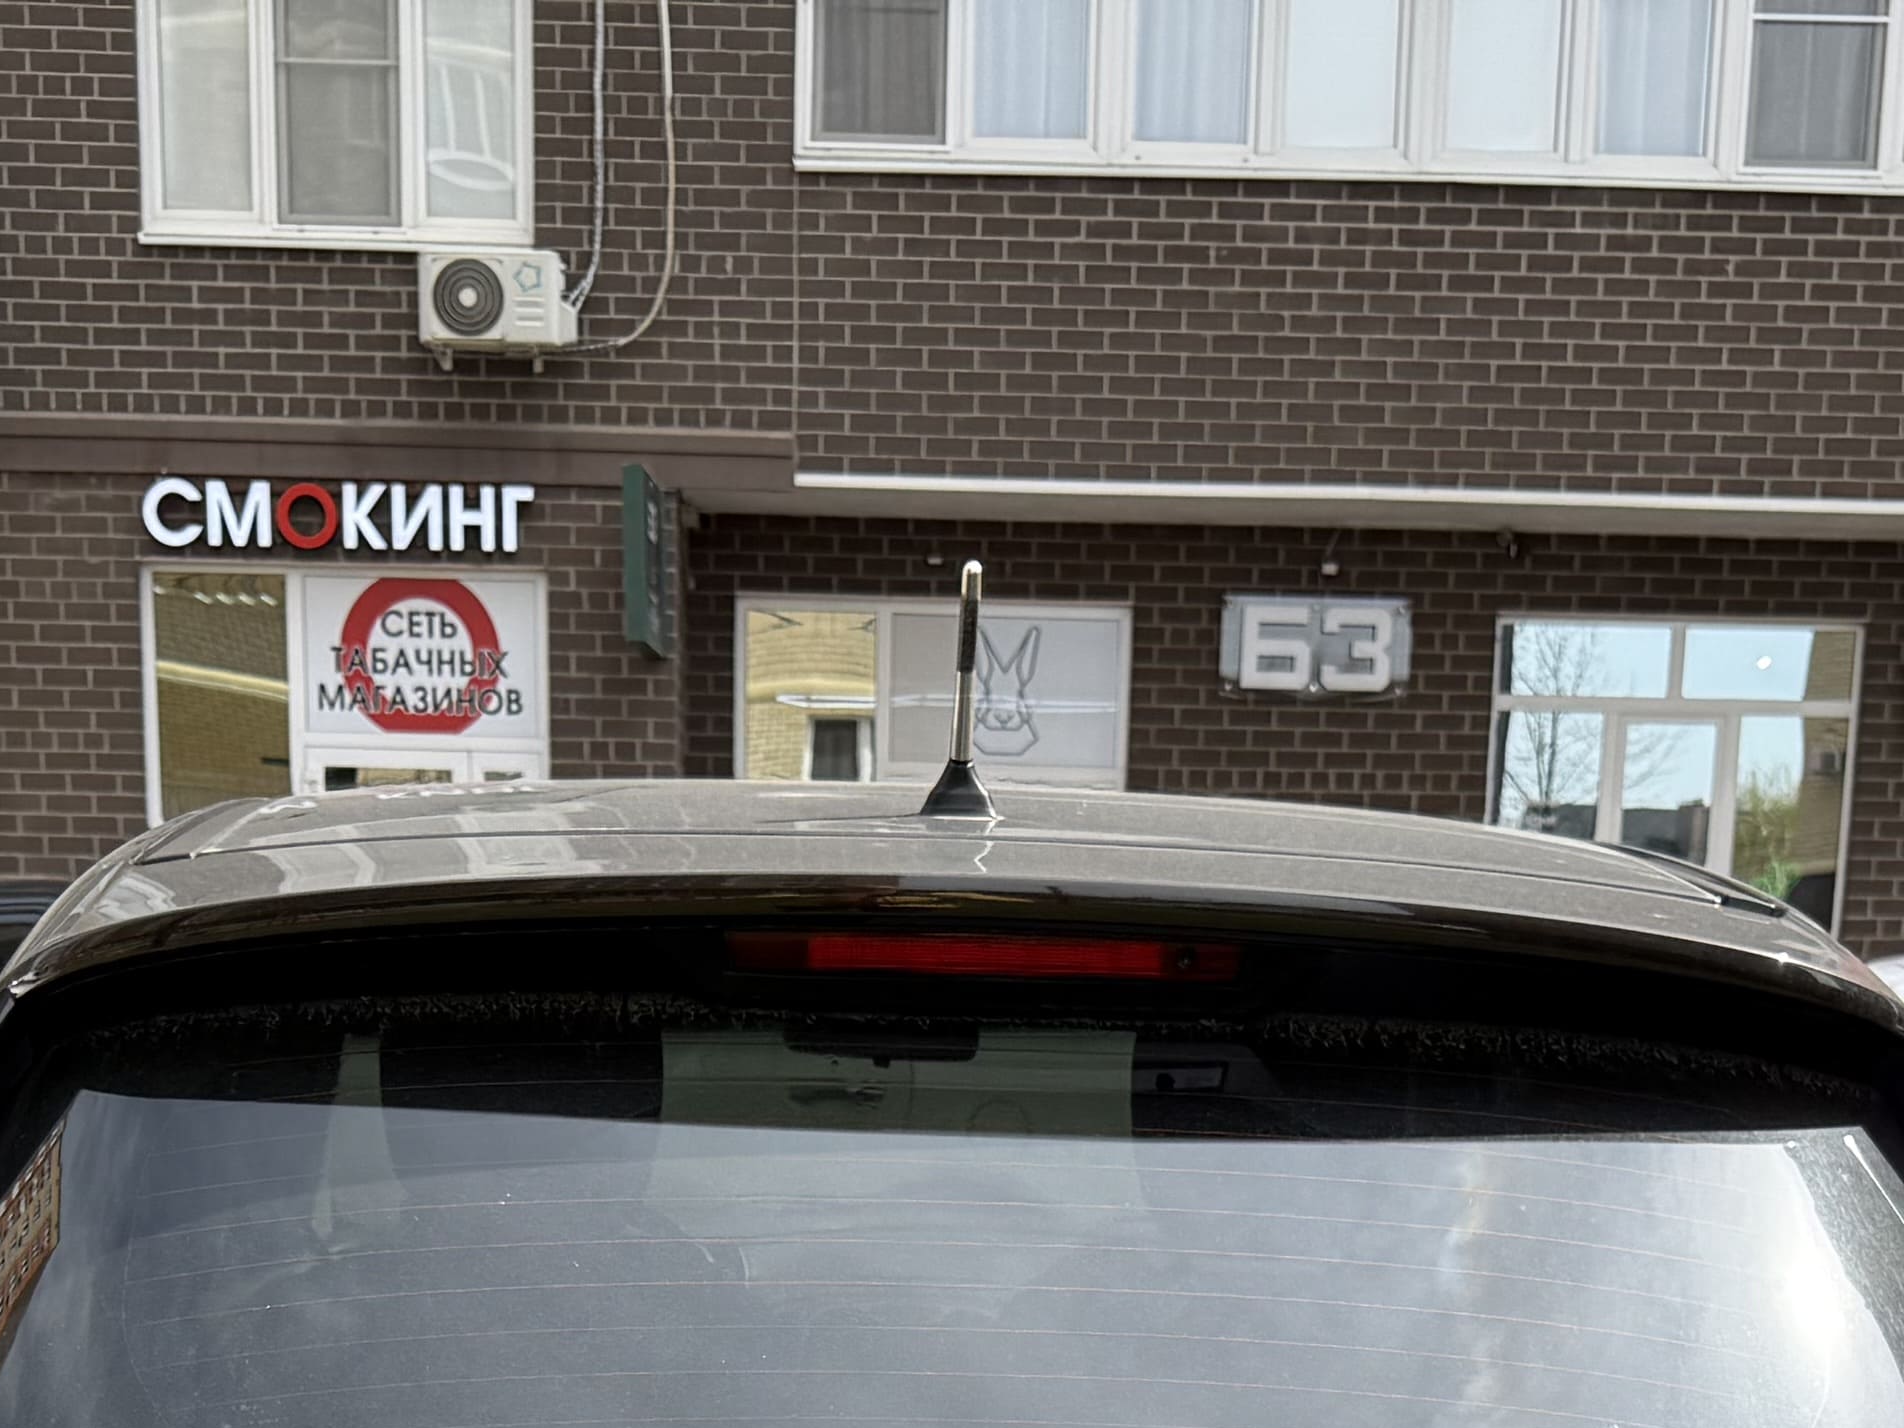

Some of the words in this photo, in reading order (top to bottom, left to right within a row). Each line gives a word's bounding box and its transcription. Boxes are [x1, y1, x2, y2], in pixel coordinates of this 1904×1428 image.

[142, 477, 535, 553] СМОКИНГ
[380, 609, 459, 639] СЕТЬ
[329, 645, 509, 680] ТАБАЧНЫХ
[1239, 606, 1393, 692] 63
[317, 683, 524, 718] МАГАЗИНОВ
